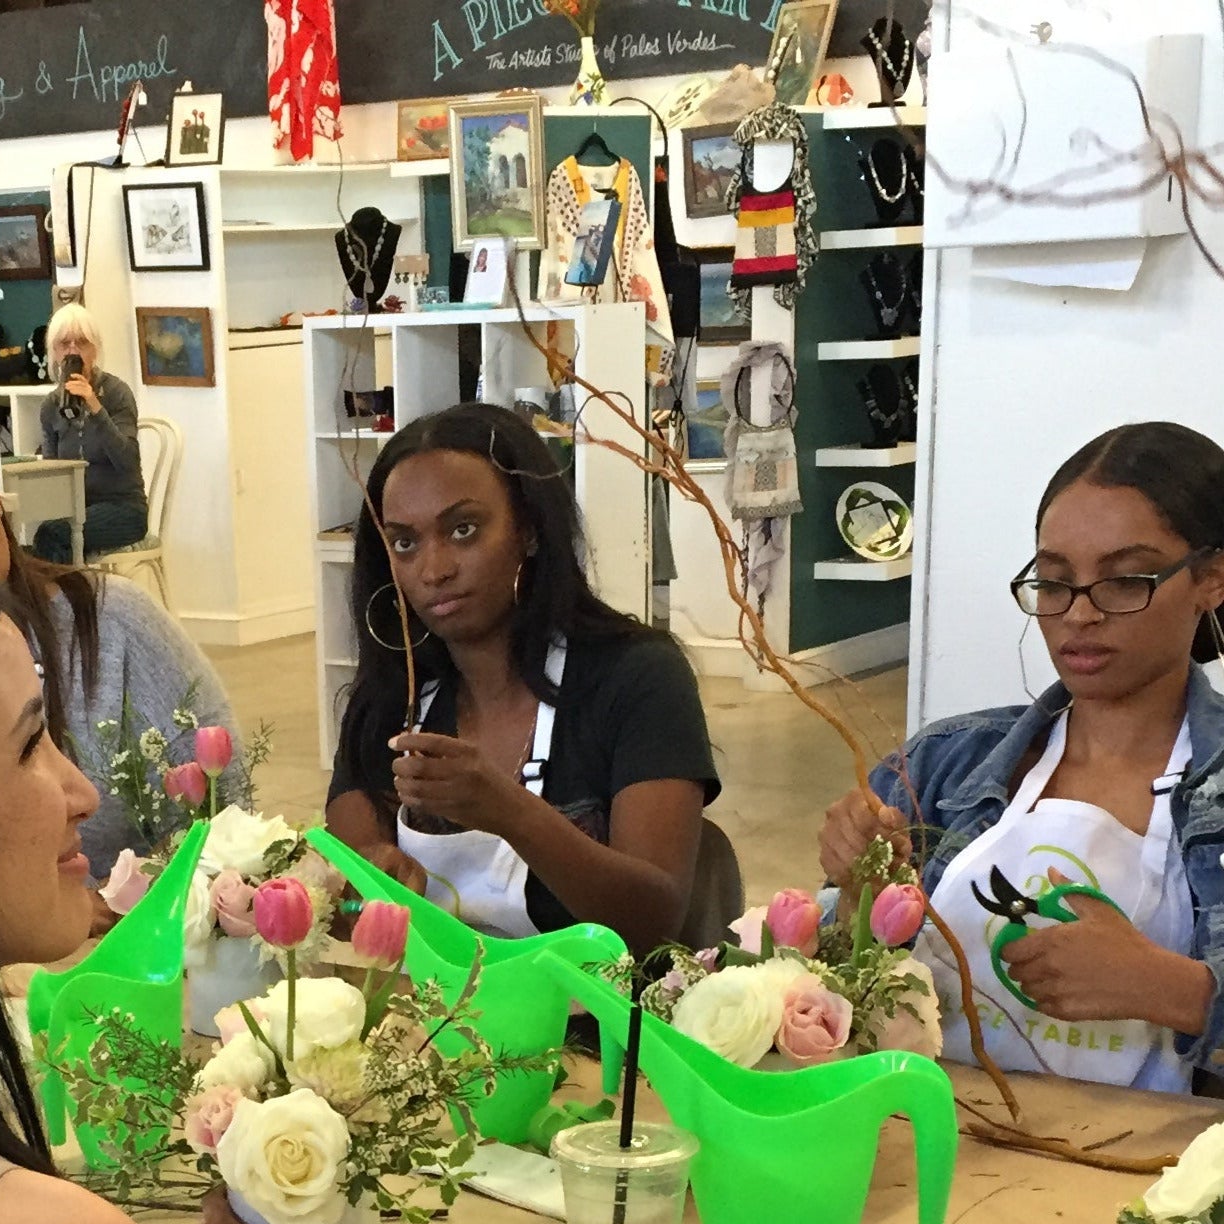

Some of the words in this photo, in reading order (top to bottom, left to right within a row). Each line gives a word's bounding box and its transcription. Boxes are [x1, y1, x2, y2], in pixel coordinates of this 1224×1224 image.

[35, 60, 53, 94] &
[66, 26, 177, 102] Apparel
[432, 19, 463, 82] A
[508, 45, 552, 70] Artists
[603, 34, 618, 64] of
[621, 33, 662, 59] Palos
[667, 30, 736, 56] Verdes
